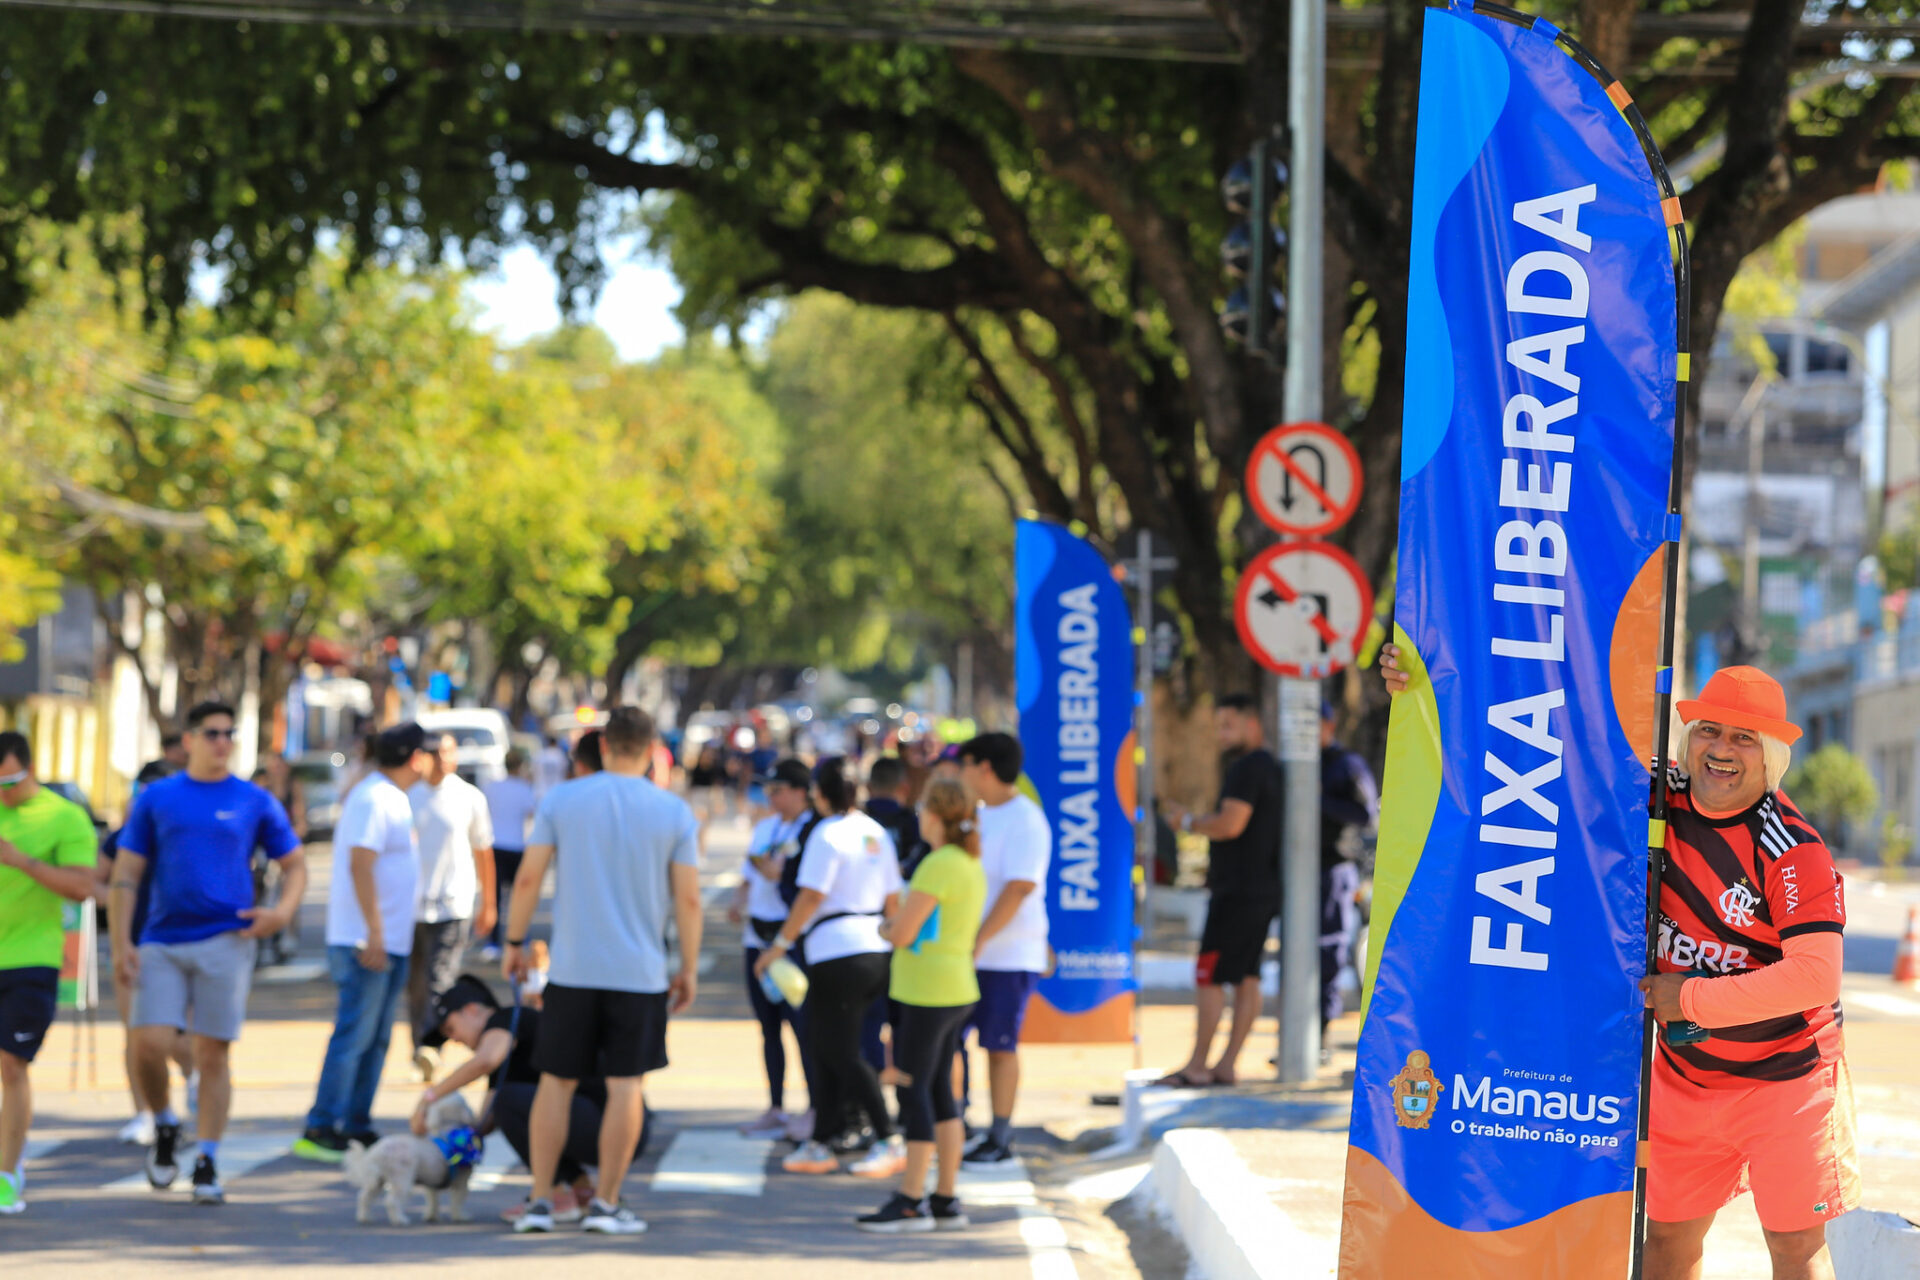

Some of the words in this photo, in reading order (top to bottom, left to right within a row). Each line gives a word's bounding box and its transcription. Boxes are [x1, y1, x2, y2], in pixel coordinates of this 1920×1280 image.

[1491, 183, 1597, 662] LIBERADA
[1058, 583, 1099, 784] LIBERADA
[1059, 789, 1100, 911] FAIXA
[1470, 688, 1565, 971] FAIXA
[1670, 932, 1749, 973] BRB
[1452, 1073, 1620, 1124] Manaus
[1503, 1068, 1556, 1082] Prefeitura
[1559, 1073, 1573, 1083] de
[1451, 1119, 1465, 1134] O
[1469, 1121, 1541, 1141] trabalho
[1544, 1128, 1576, 1144] não
[1580, 1134, 1619, 1148] para
